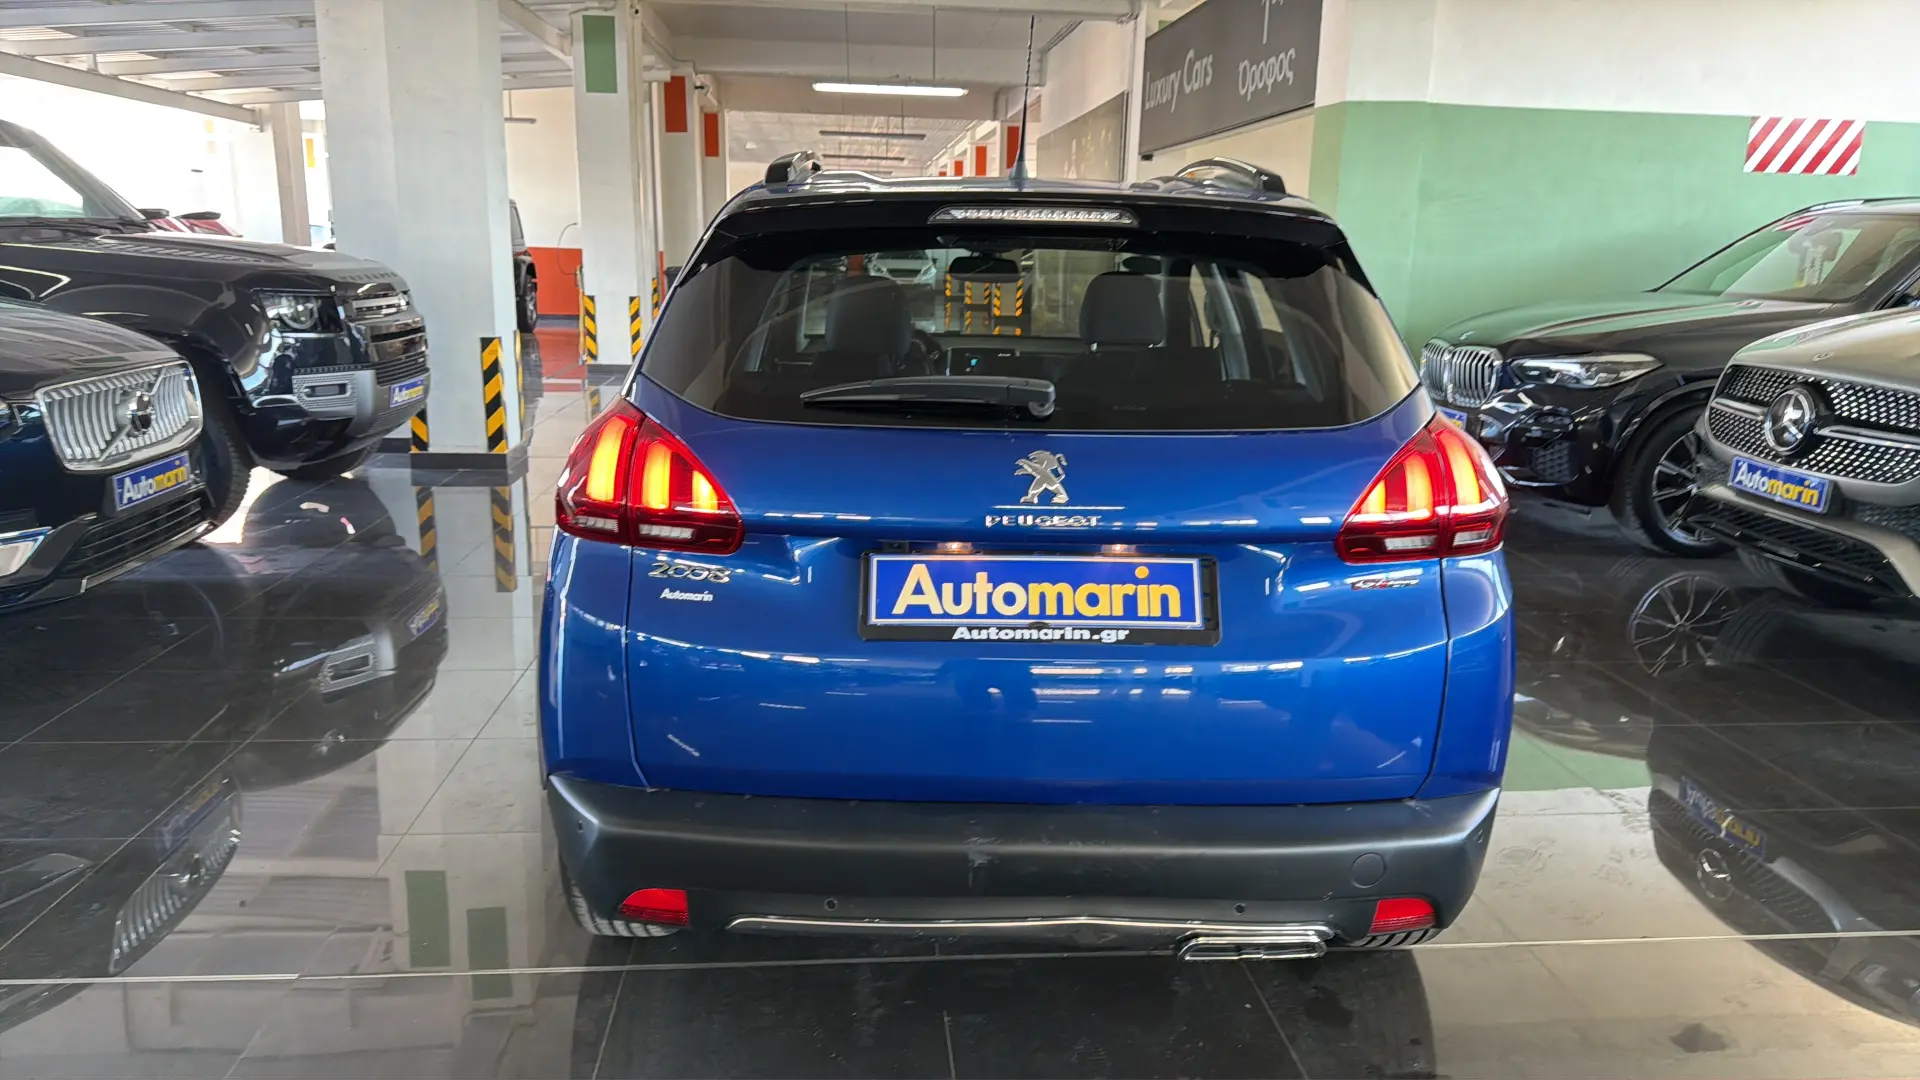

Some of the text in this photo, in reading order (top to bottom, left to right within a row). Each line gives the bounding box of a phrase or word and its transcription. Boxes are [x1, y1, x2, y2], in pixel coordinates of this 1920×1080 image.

[1145, 49, 1213, 113] Luxury Cars
[1734, 461, 1819, 506] Automarin
[985, 515, 1102, 528] PEUGEOT
[648, 561, 731, 583] 2008
[660, 588, 713, 602] Automarin
[891, 563, 1182, 618] Automarin
[951, 626, 1130, 644] Automarin.gr
